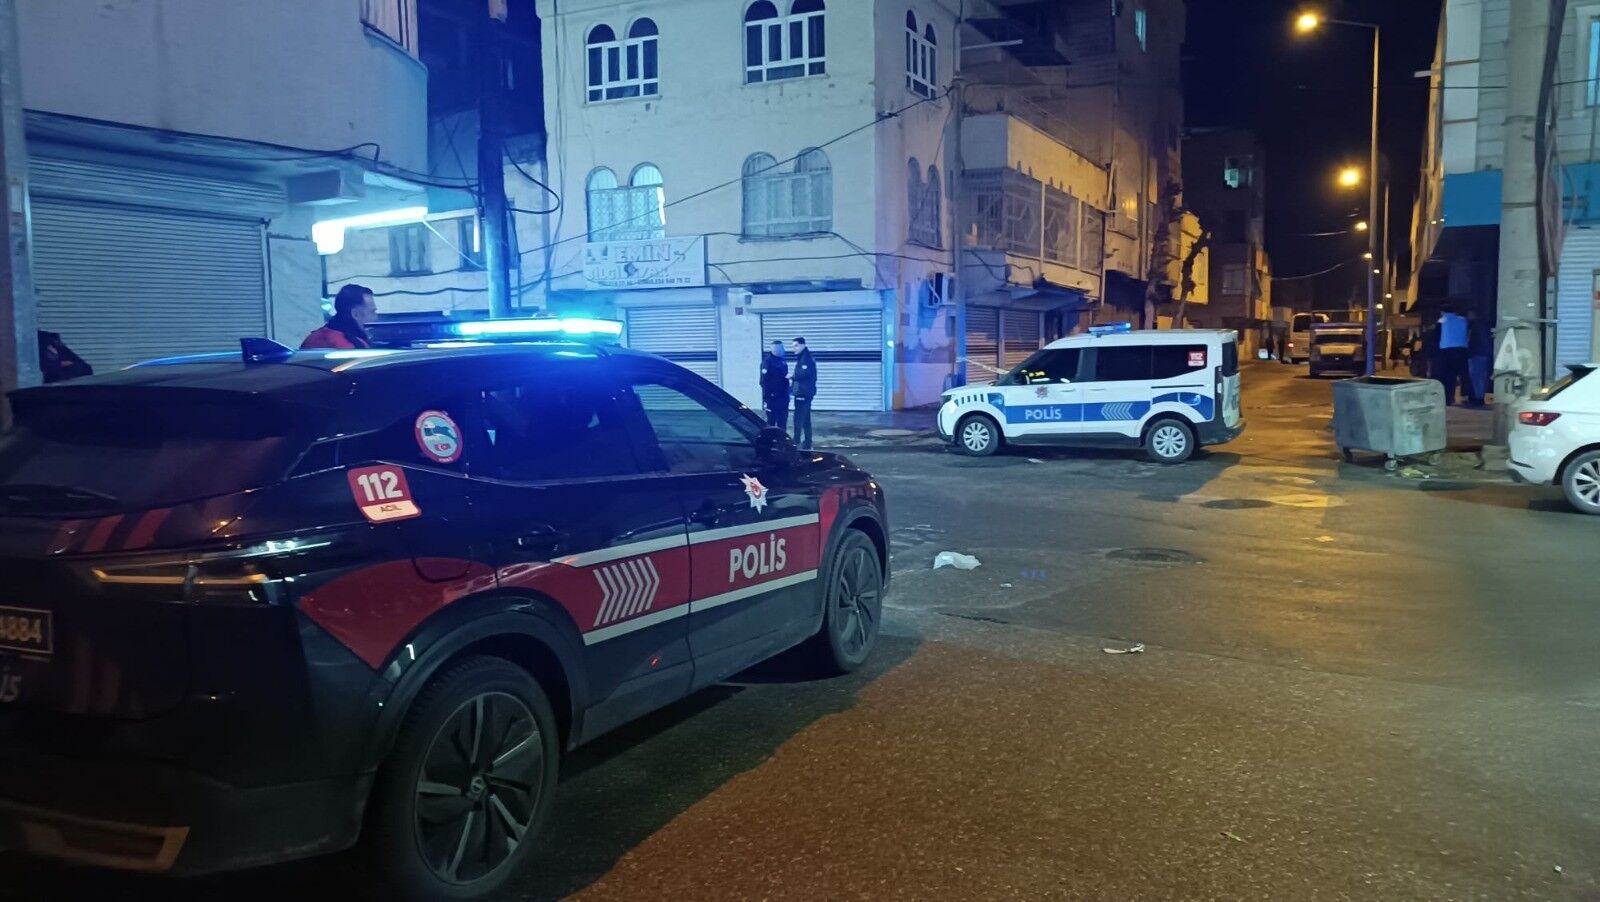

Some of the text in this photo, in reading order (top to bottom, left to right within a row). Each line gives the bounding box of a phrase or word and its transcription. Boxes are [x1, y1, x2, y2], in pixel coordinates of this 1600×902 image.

[1025, 405, 1062, 421] POLİS
[357, 471, 404, 502] 112
[729, 533, 786, 583] POLİS
